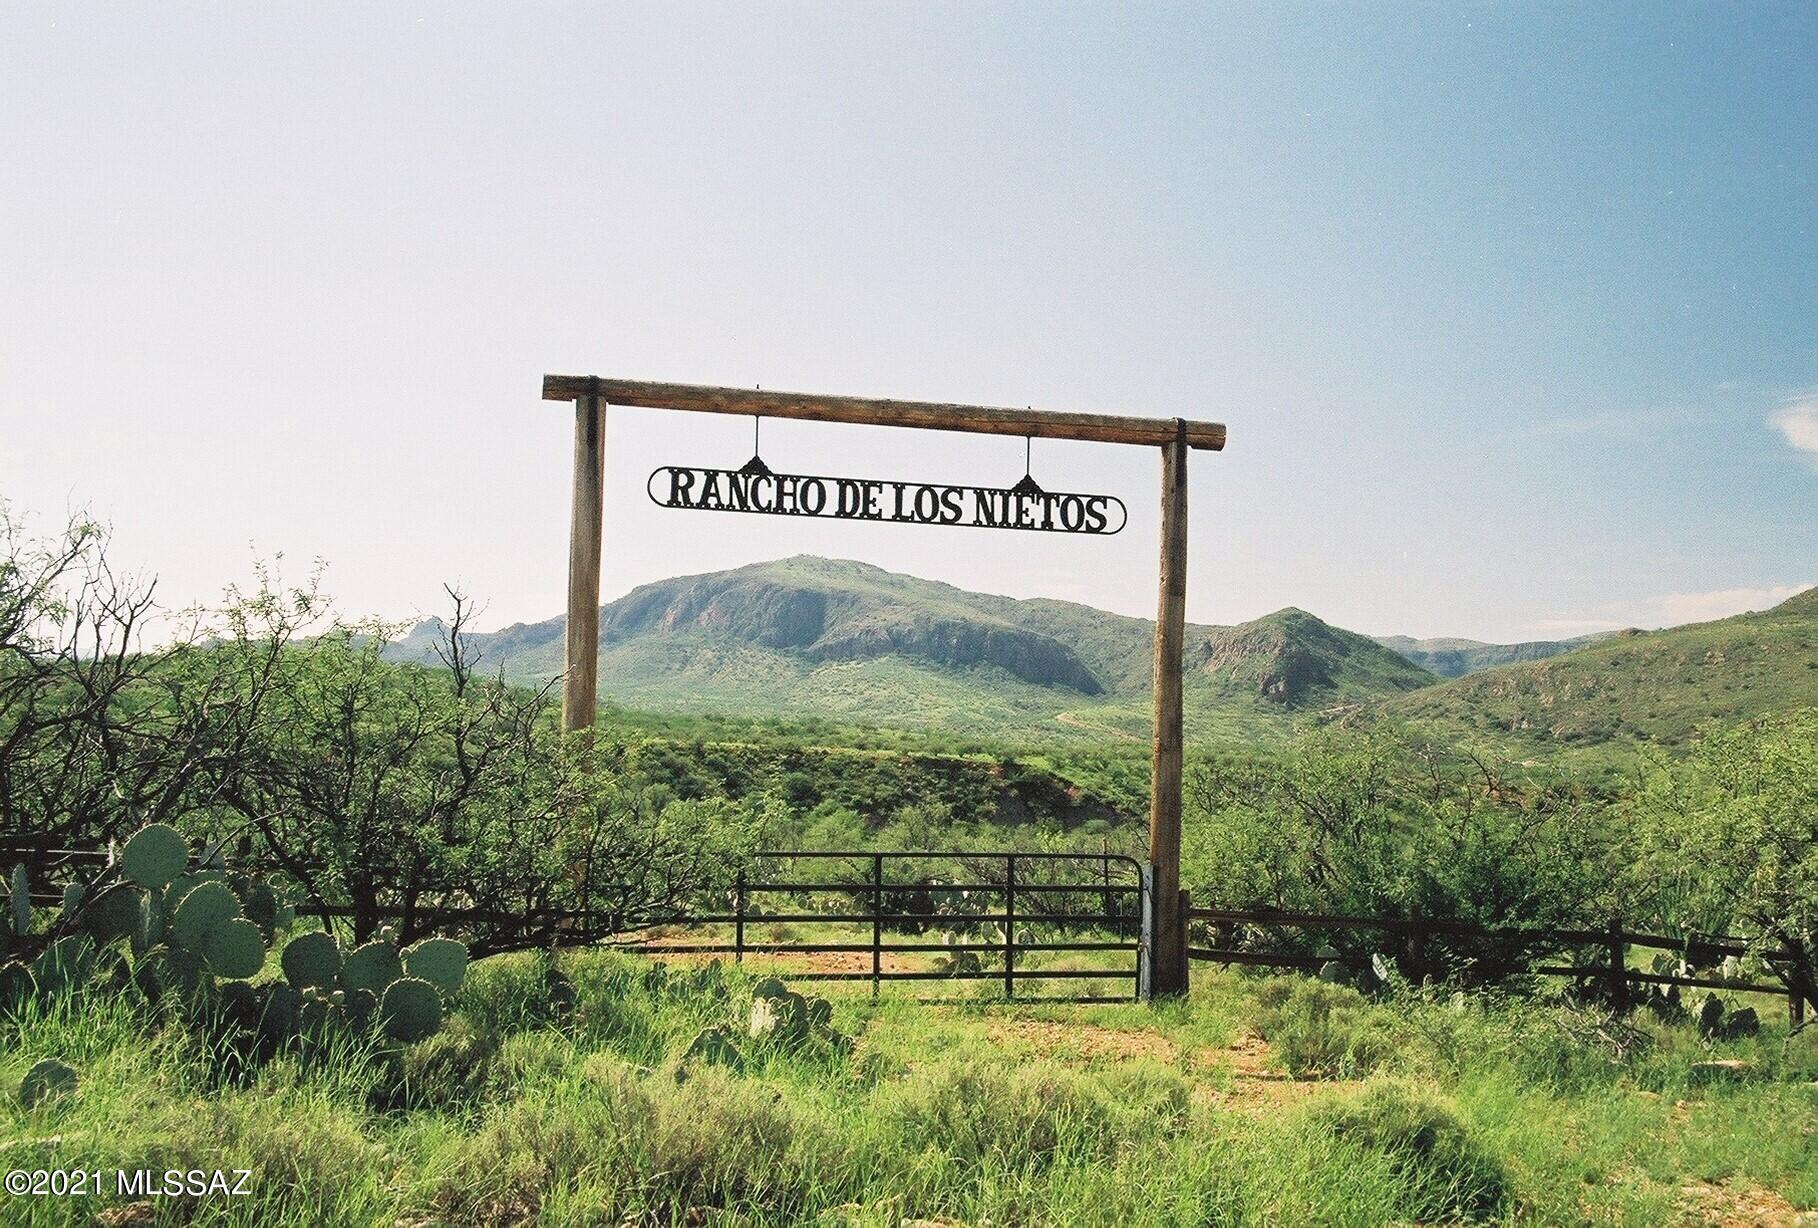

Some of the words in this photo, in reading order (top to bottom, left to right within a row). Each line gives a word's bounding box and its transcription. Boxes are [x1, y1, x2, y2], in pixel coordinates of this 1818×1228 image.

[667, 468, 826, 515] RANCHO
[835, 479, 883, 519] DE
[892, 483, 963, 524] LOS
[973, 489, 1108, 532] NIETOS
